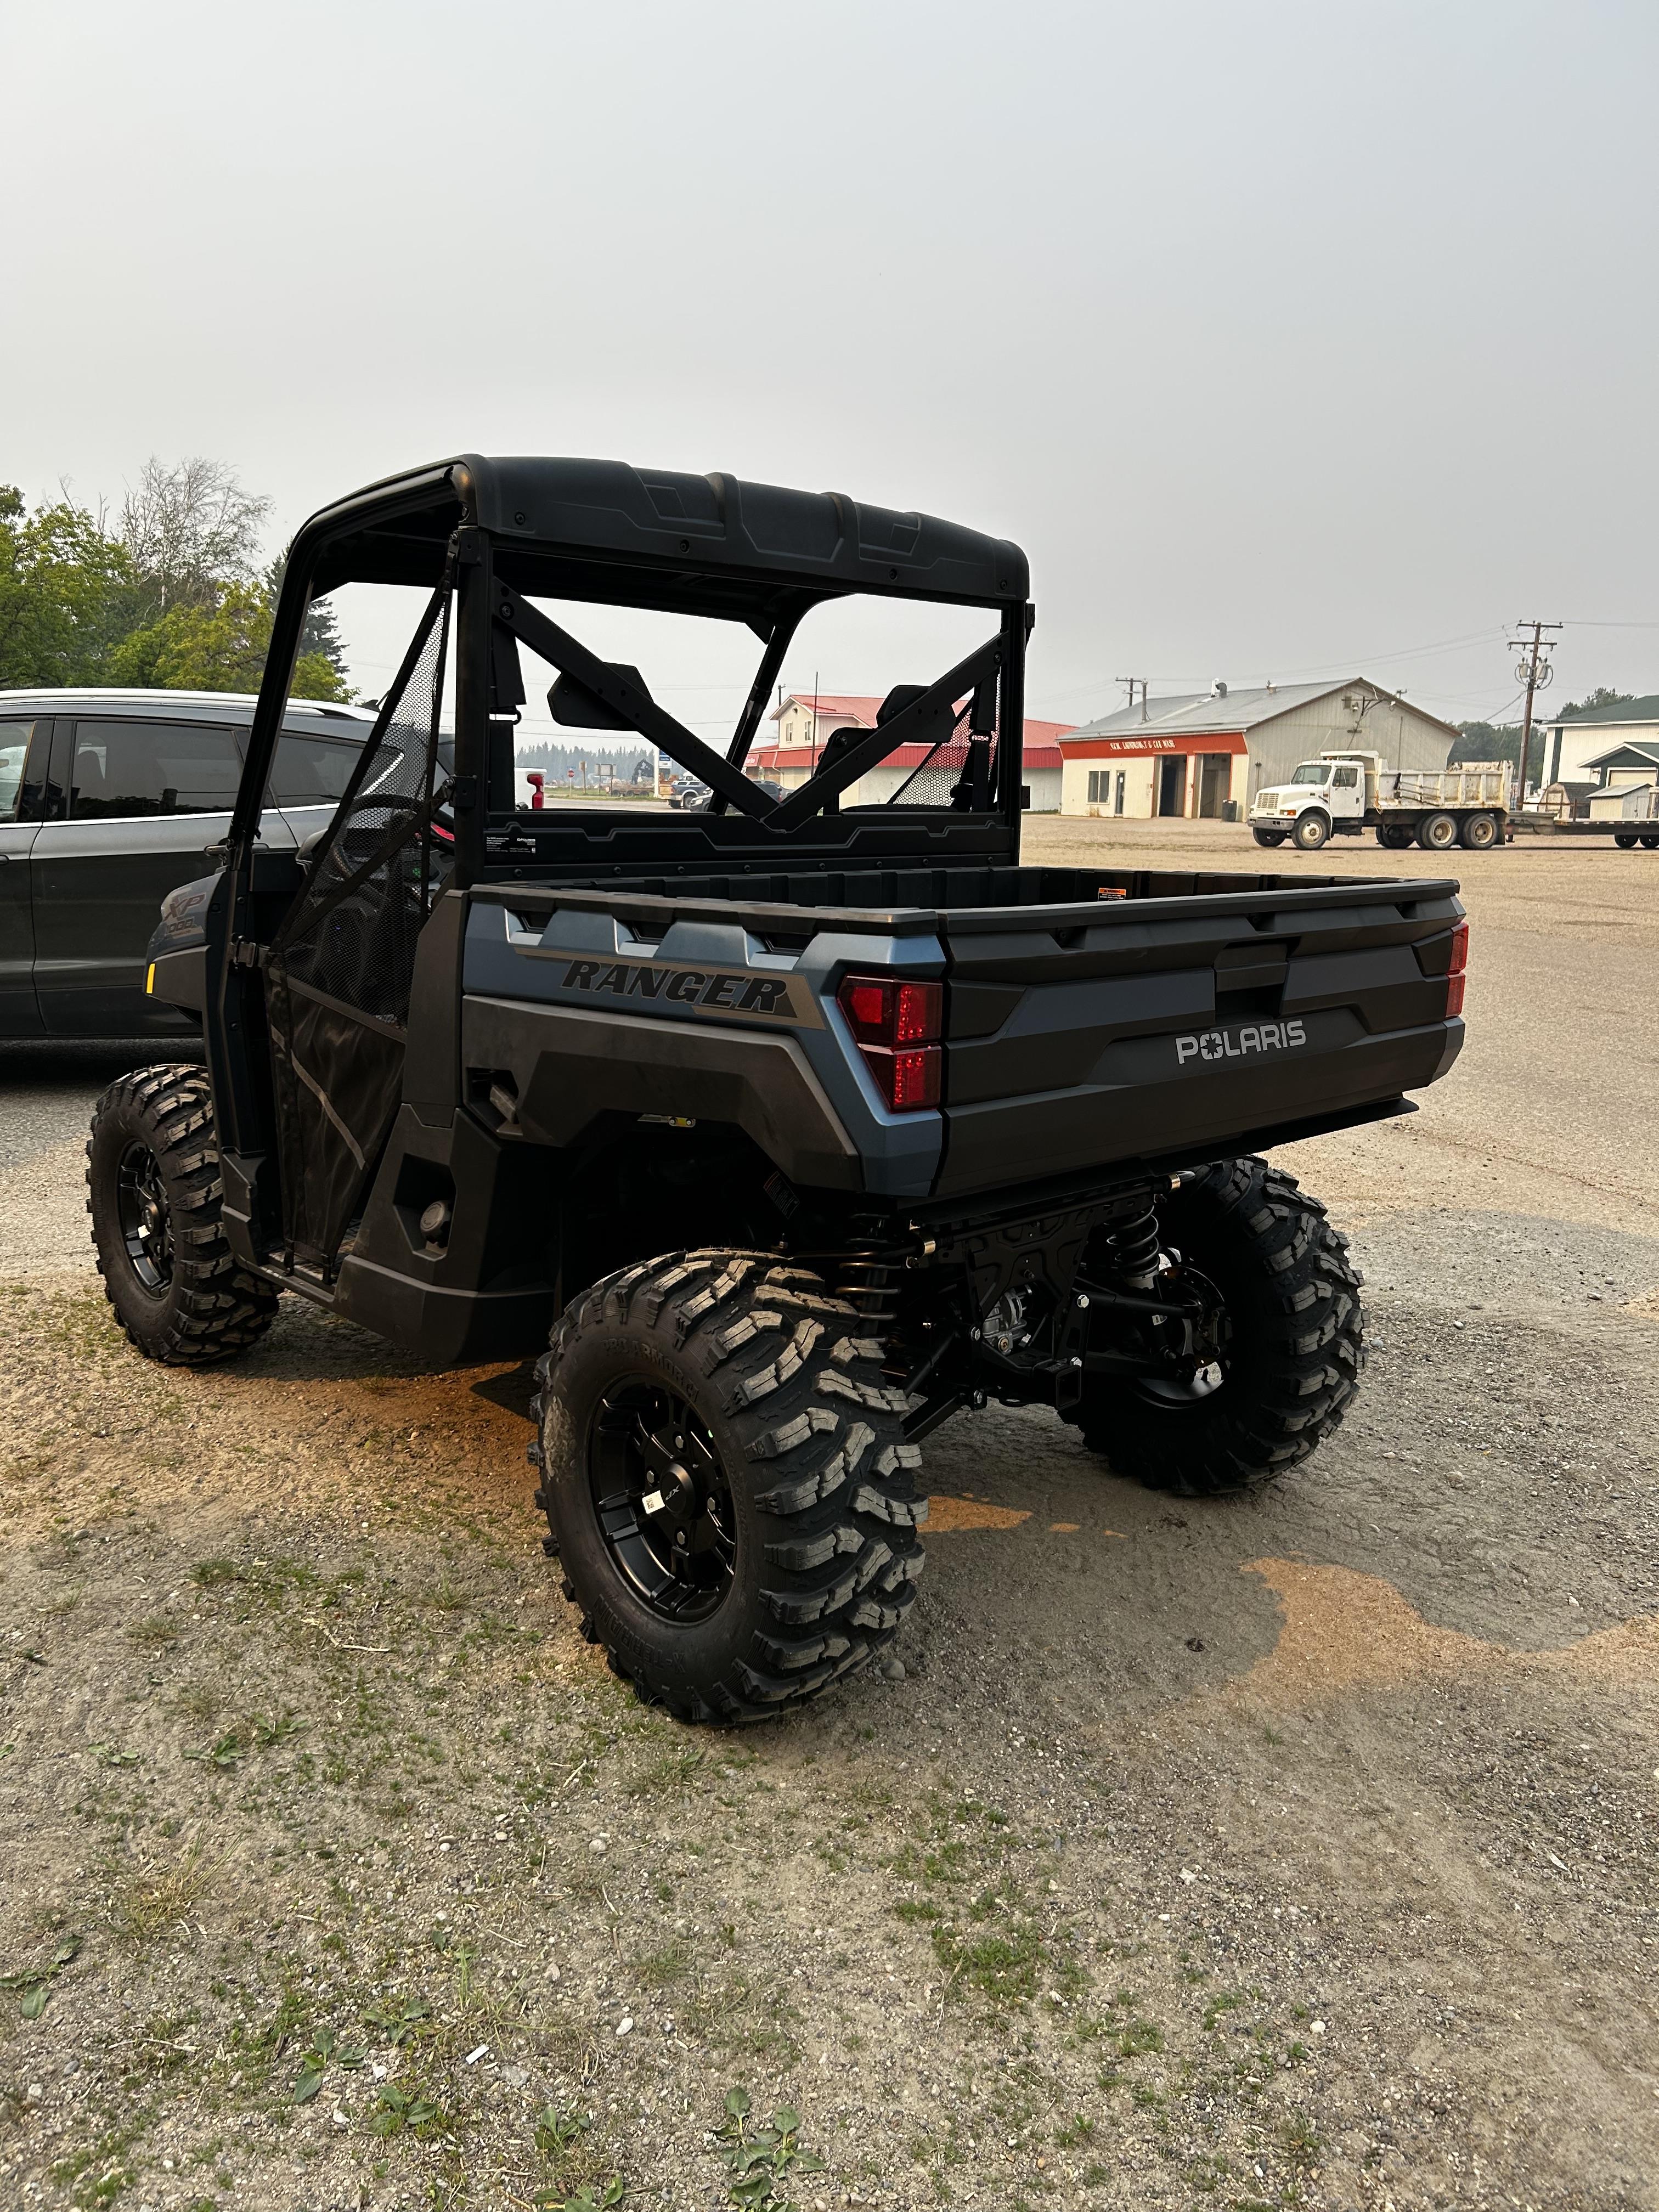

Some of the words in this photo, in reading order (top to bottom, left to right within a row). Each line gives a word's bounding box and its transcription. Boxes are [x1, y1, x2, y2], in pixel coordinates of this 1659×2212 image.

[165, 893, 206, 922] XP
[561, 960, 787, 1014] RANGER
[1175, 1020, 1306, 1065] POLARIS
